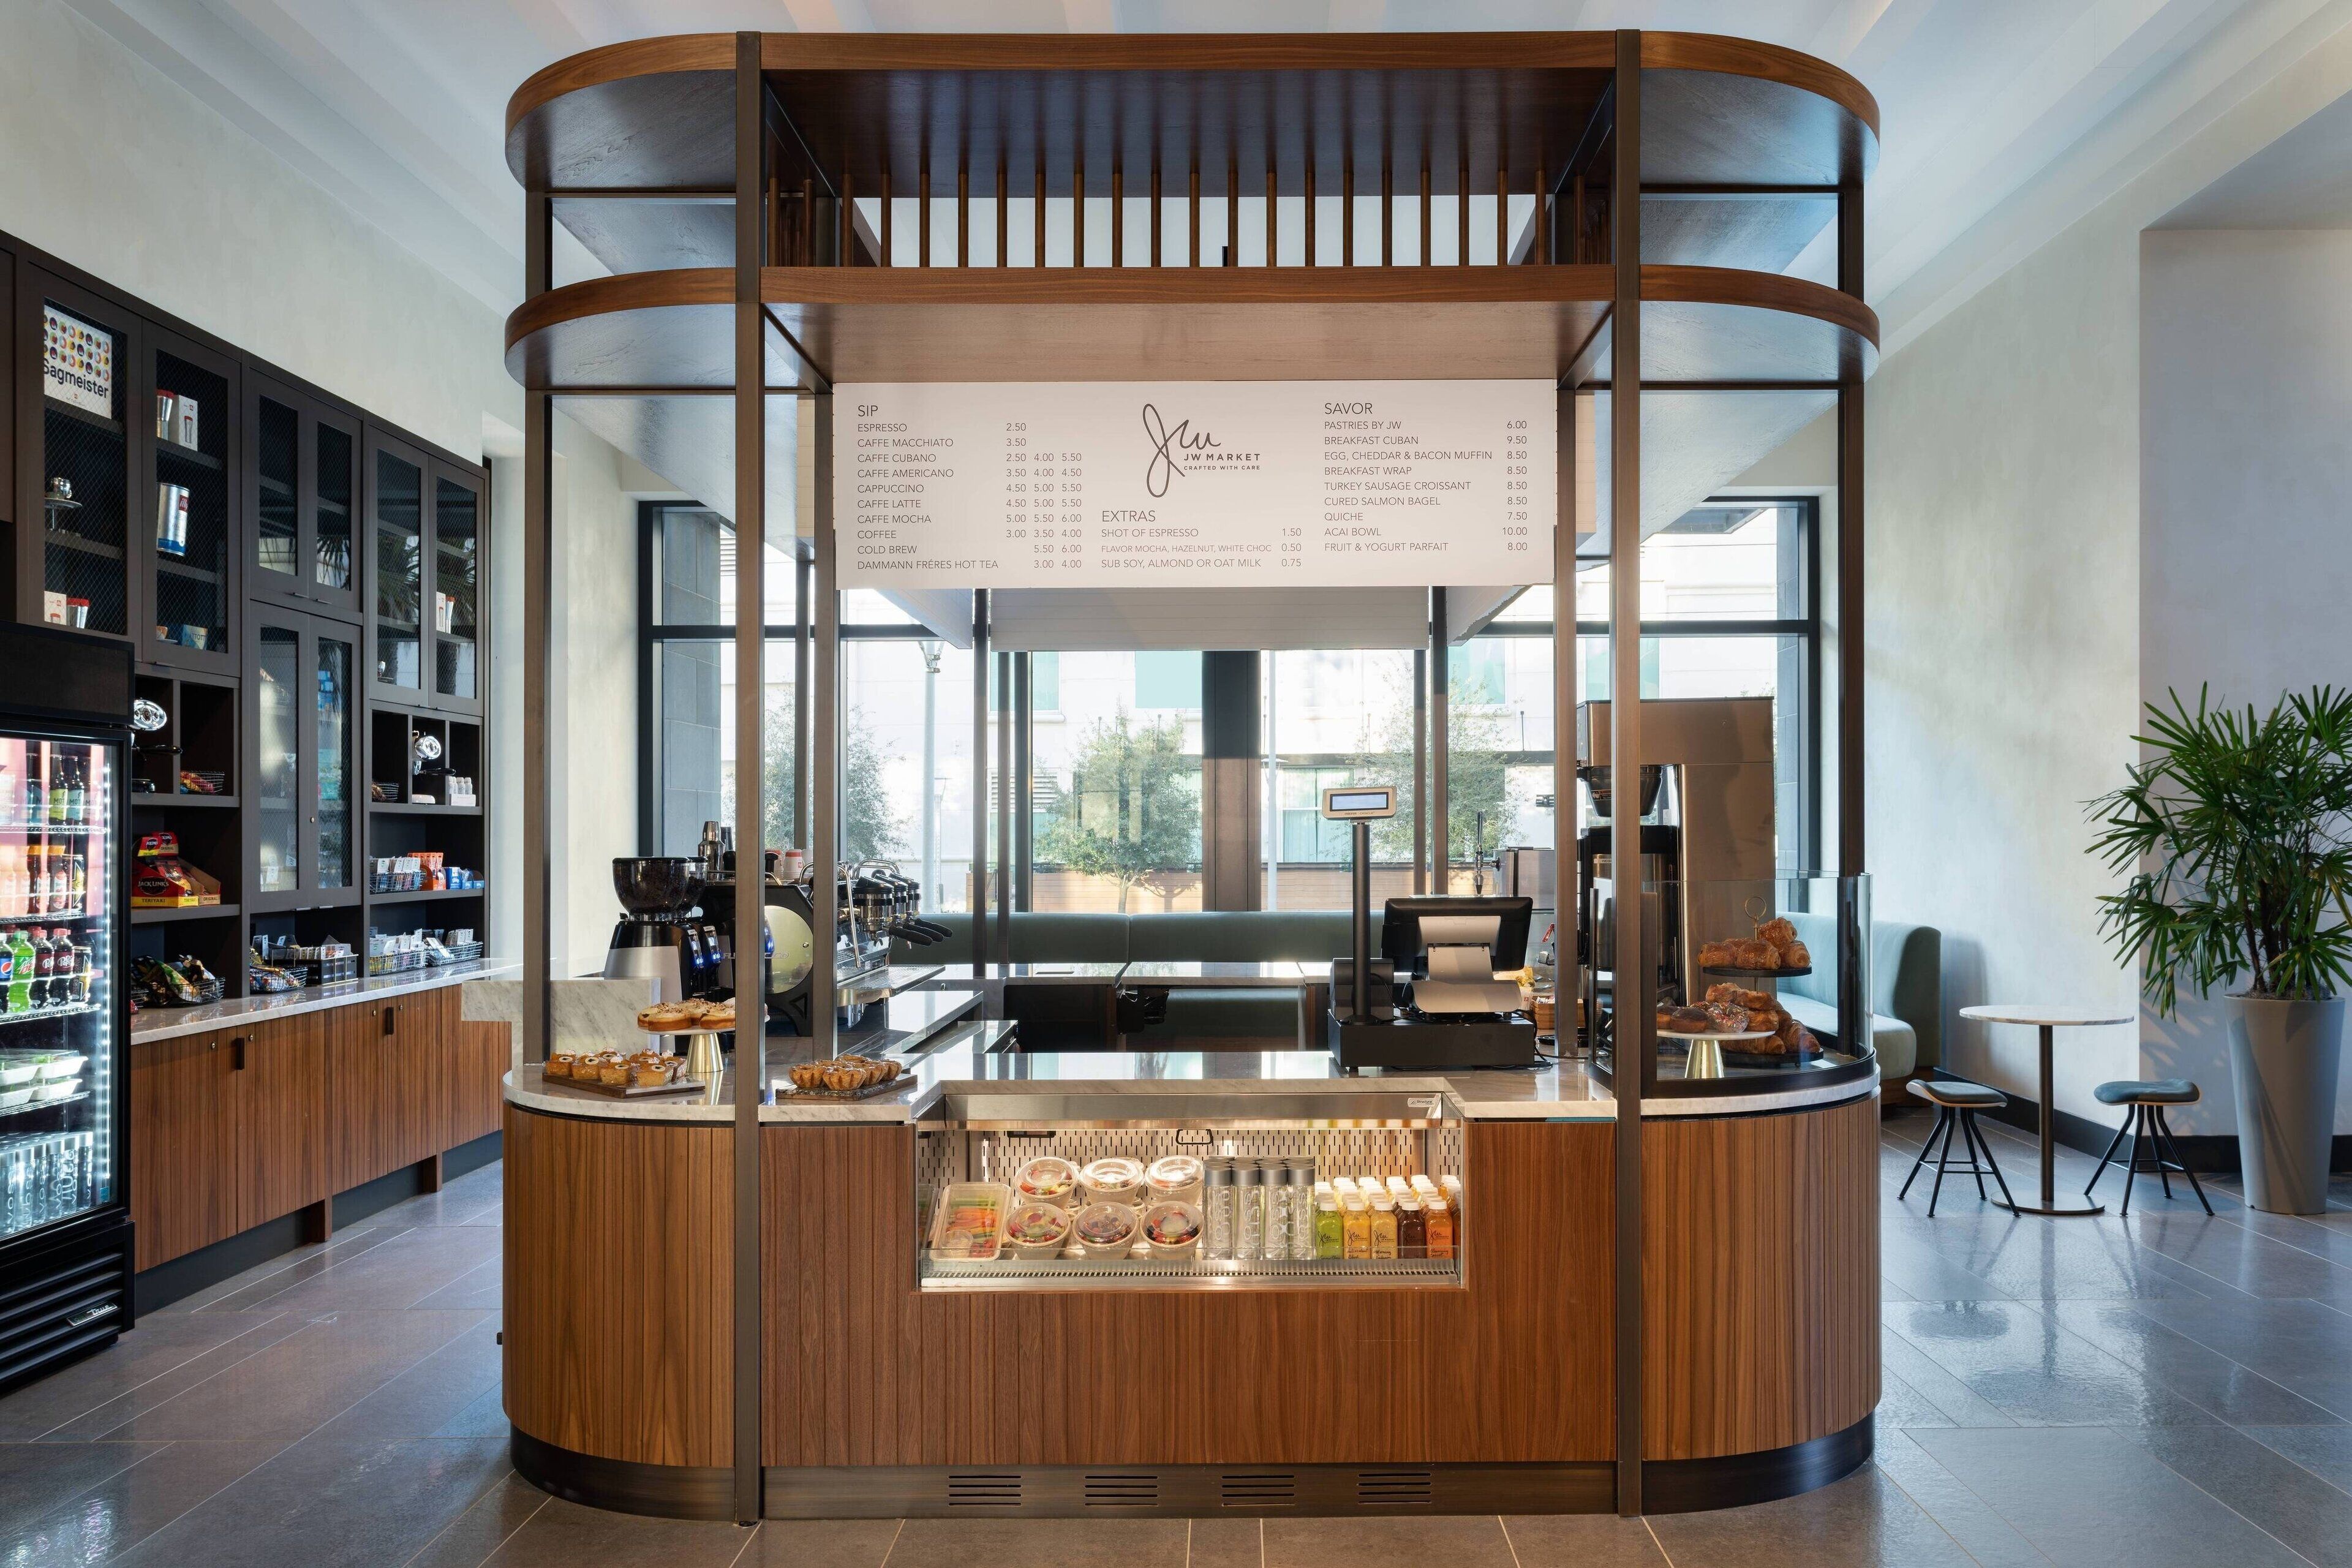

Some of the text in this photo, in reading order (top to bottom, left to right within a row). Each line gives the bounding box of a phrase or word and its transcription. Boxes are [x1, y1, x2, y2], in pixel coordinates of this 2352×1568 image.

[43, 357, 109, 398] Sagmeister
[858, 404, 878, 417] SIP
[1324, 402, 1373, 415] SAVOR
[858, 423, 1027, 432] ESPRESSO 2.50
[1324, 420, 1527, 430] PASTRIES BY JW 6.00
[857, 437, 1027, 448] CAFFE MACCHIATO 3.50
[1324, 435, 1527, 445] BREAKFAST CUBAN 9.50
[857, 453, 1082, 463] CAFFE CUBANO 2.50 4.00 5.50
[1324, 451, 1528, 462] EGG, CHEDDAR & BACON MUFFIN 8.50
[857, 468, 1082, 478] CAFFE AMERICANO 3.50 4.00 4.50
[1324, 465, 1528, 476] BREAKFAST WRAP 8.50
[857, 483, 1082, 494] CAPPUCCINO 4.50 5.00 5.50
[1324, 481, 1528, 491] TURKEY SAUSAGE CROISSANT 8.50
[857, 498, 1082, 509] CAFFE LATTE 4.50 5.00 5.50
[1324, 496, 1528, 506] CURED SALMON BAGEL 8.50
[857, 513, 1082, 524] CAFFE MOCHA 5.00 5.50 6.00
[1102, 510, 1156, 522] EXTRAS
[1324, 511, 1528, 521] QUICHE 7.50
[857, 529, 1082, 539] COFFEE 3.00 3.50 4.00
[1101, 527, 1302, 538] SHOT OF ESPRESSO 1.50
[1324, 526, 1528, 537] ACAI BOWL 10.00
[857, 544, 1082, 554] COLD BREW 5.50 6.00
[1172, 545, 1216, 553] HAZELNUT,
[1281, 543, 1302, 552] 0.50
[1325, 542, 1528, 552] FRUIT & YOGURT PARFAIT 8.00
[857, 558, 1082, 570] DAMMANN FRÉRES HOT TEA 3.00 4.00
[1101, 558, 1302, 569] SUB SOY, ALMOND OR OAT MILK 0.75
